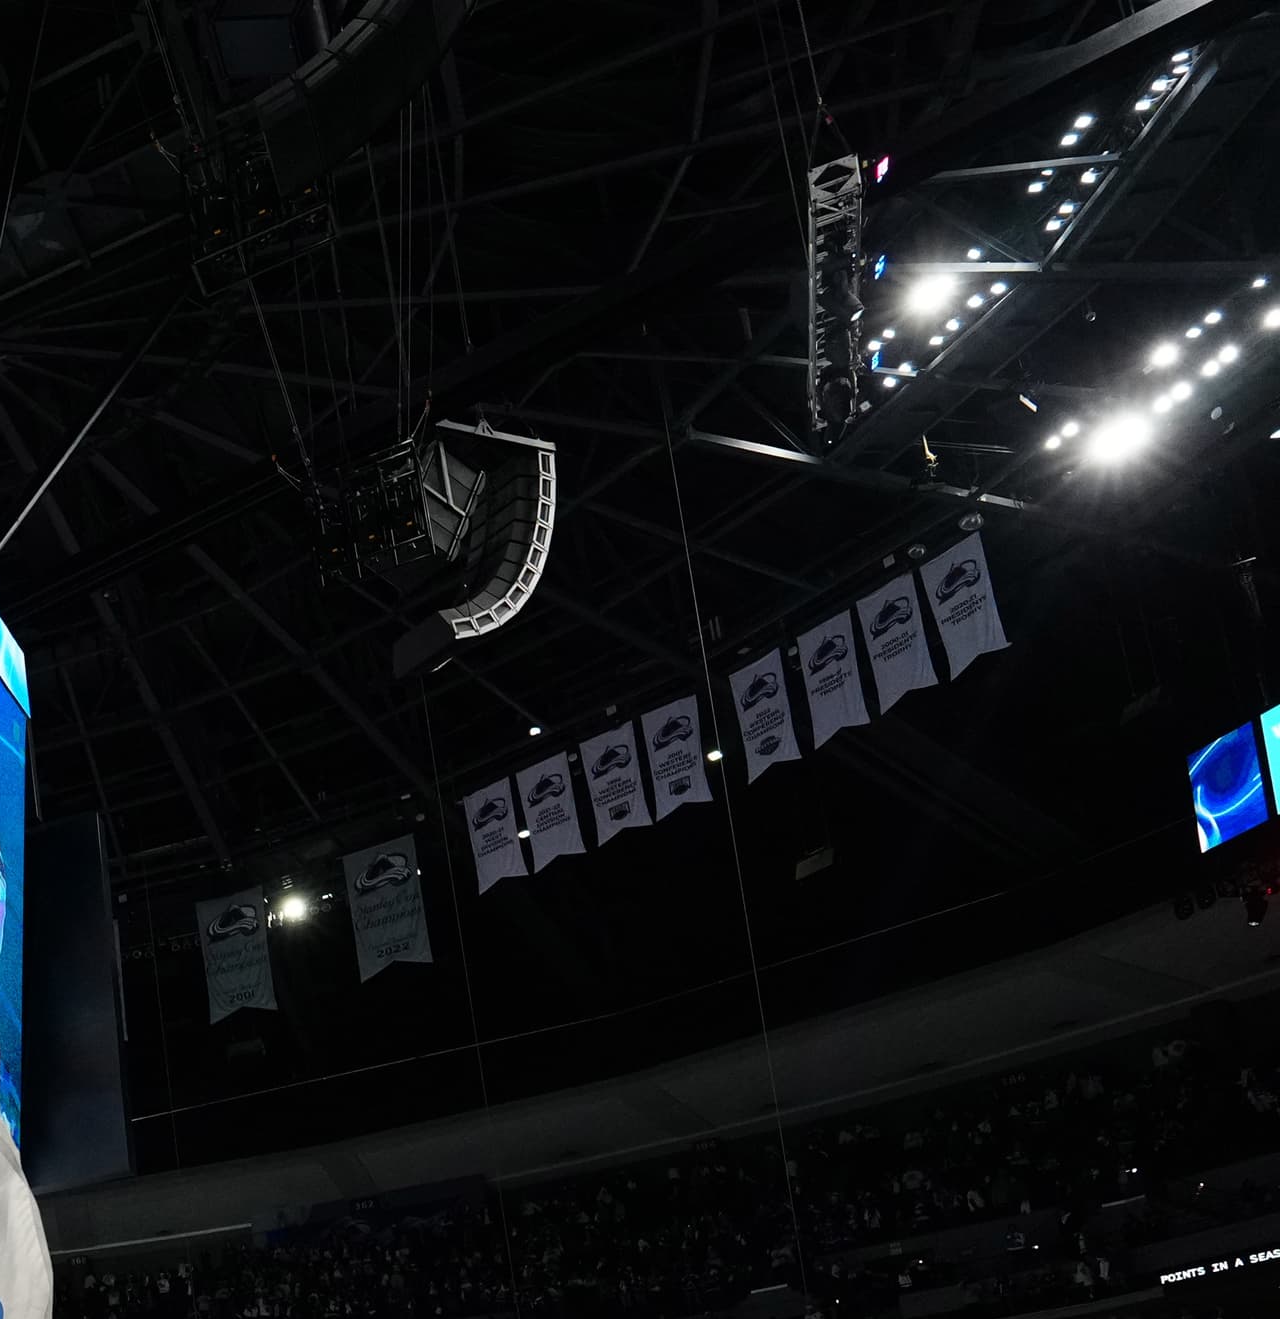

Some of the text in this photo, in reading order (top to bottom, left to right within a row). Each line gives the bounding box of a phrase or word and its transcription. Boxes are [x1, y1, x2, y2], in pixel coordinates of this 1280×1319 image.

[1160, 1266, 1206, 1285] POINTS
[1211, 1260, 1229, 1273] IN
[1234, 1258, 1244, 1268] A
